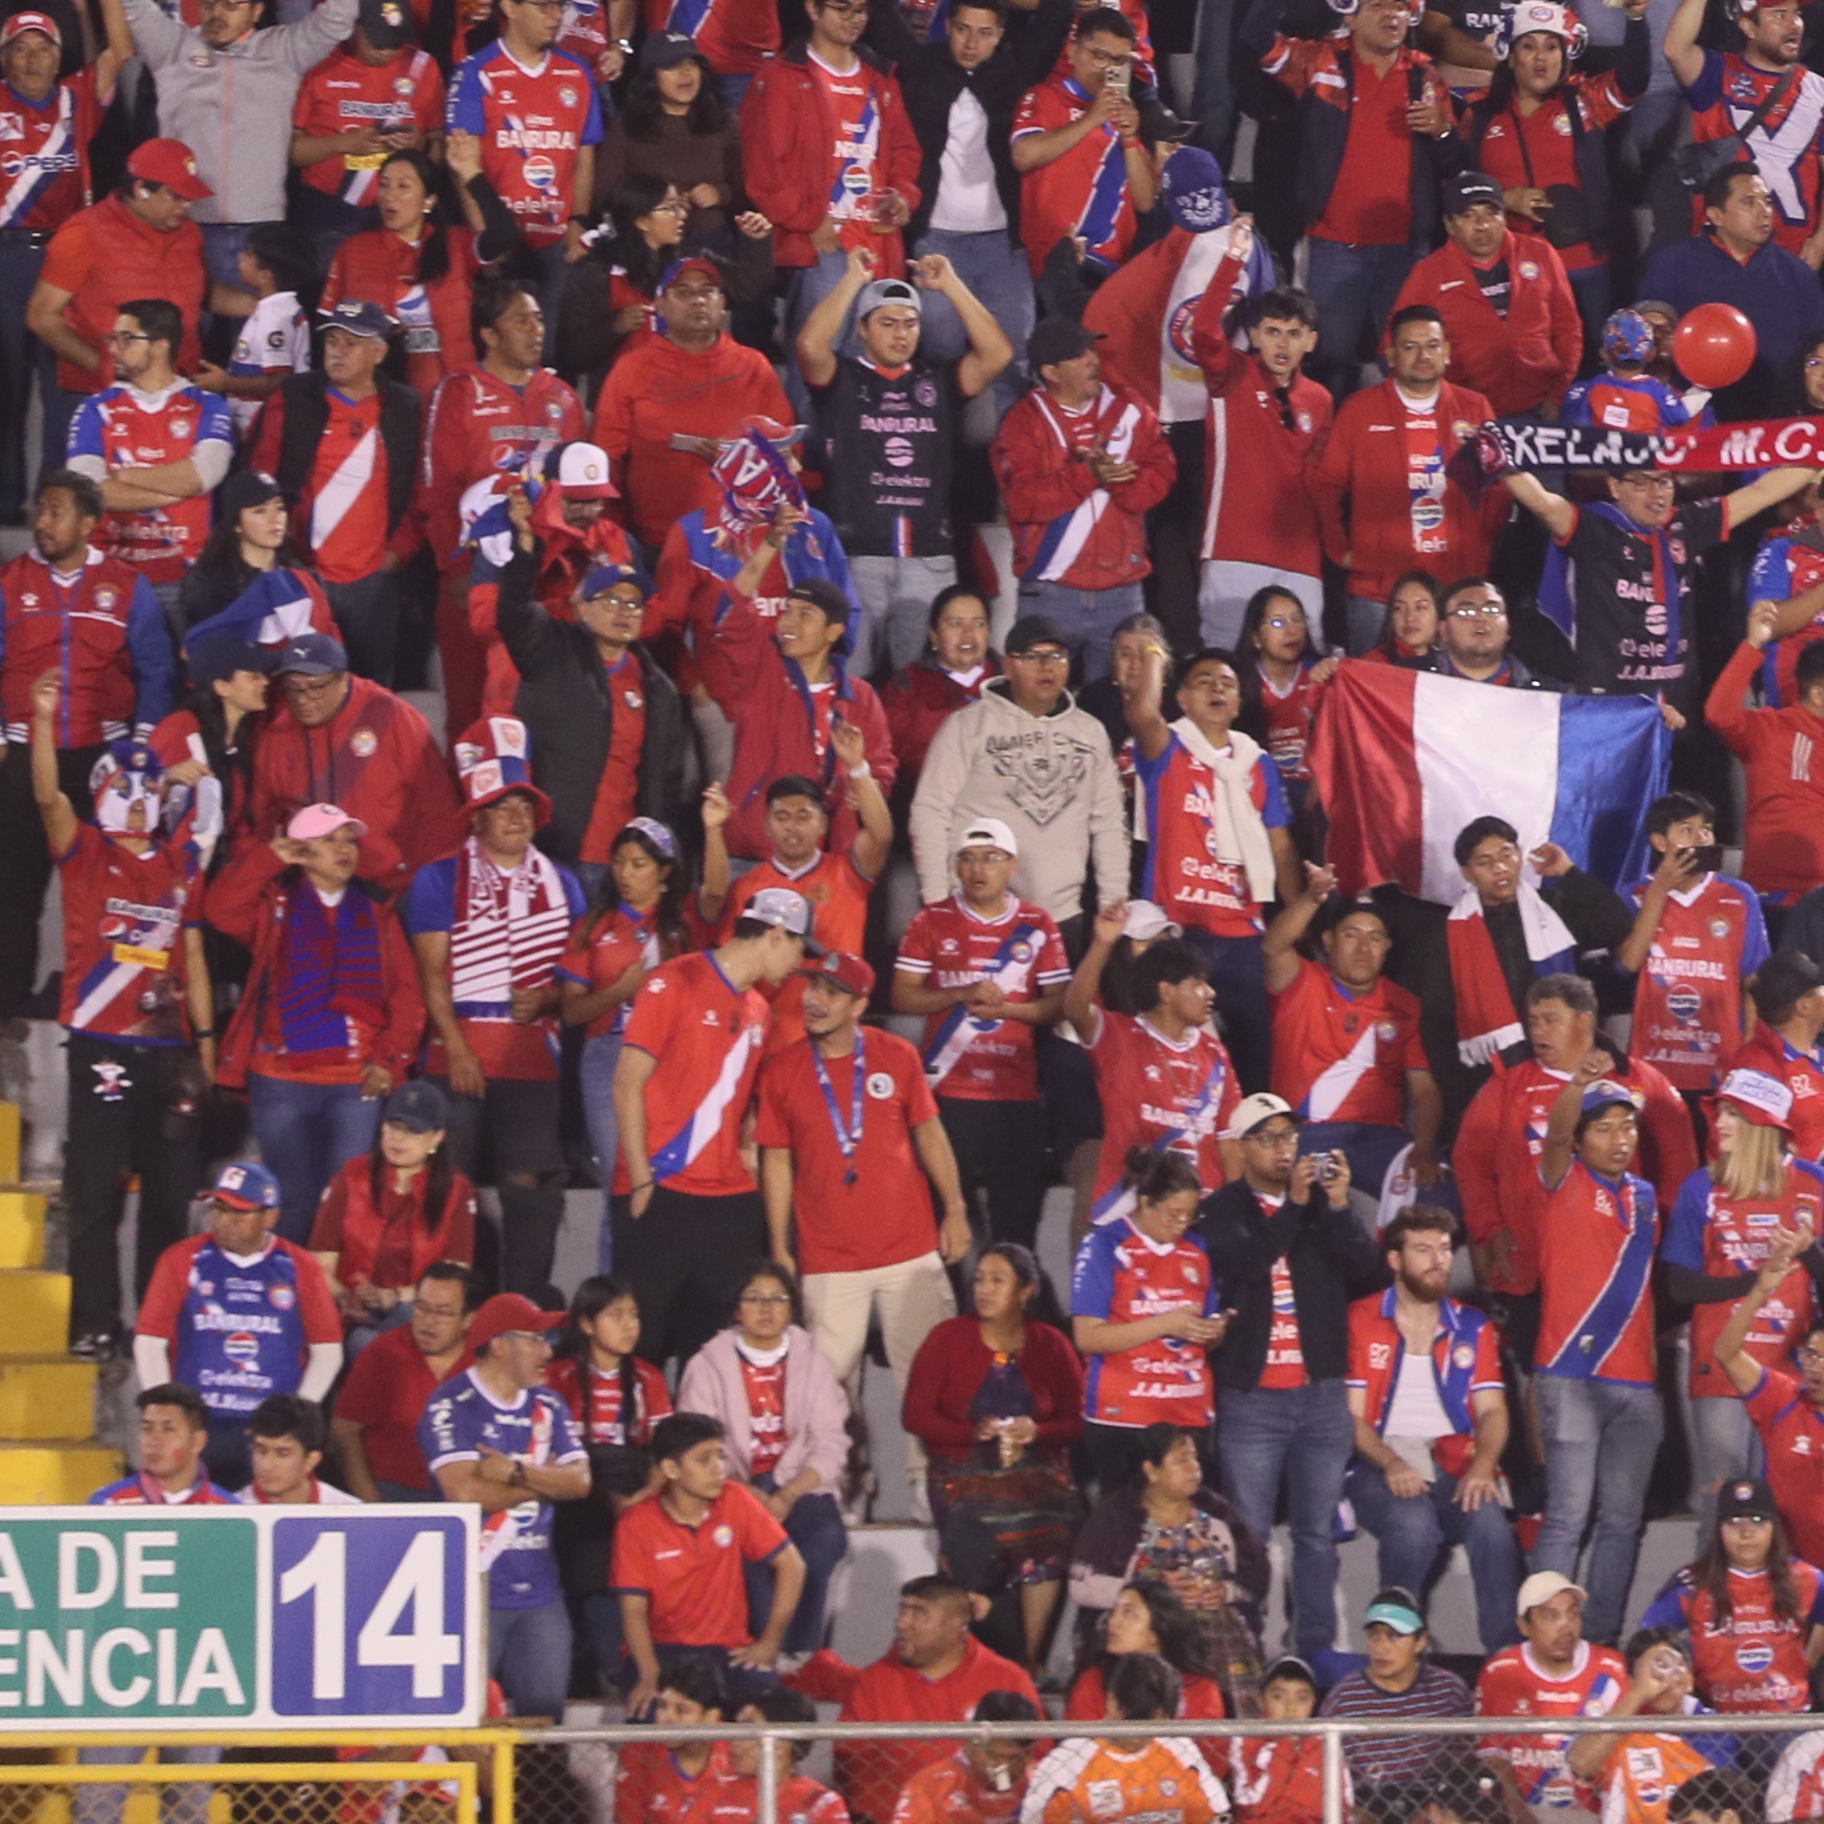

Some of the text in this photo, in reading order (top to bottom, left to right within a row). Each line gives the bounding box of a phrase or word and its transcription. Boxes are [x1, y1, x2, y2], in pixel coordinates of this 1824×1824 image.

[496, 130, 577, 150] BANRURAL
[860, 416, 938, 435] BANRURAL
[58, 1531, 180, 1609] DE
[279, 1530, 462, 1701] 14
